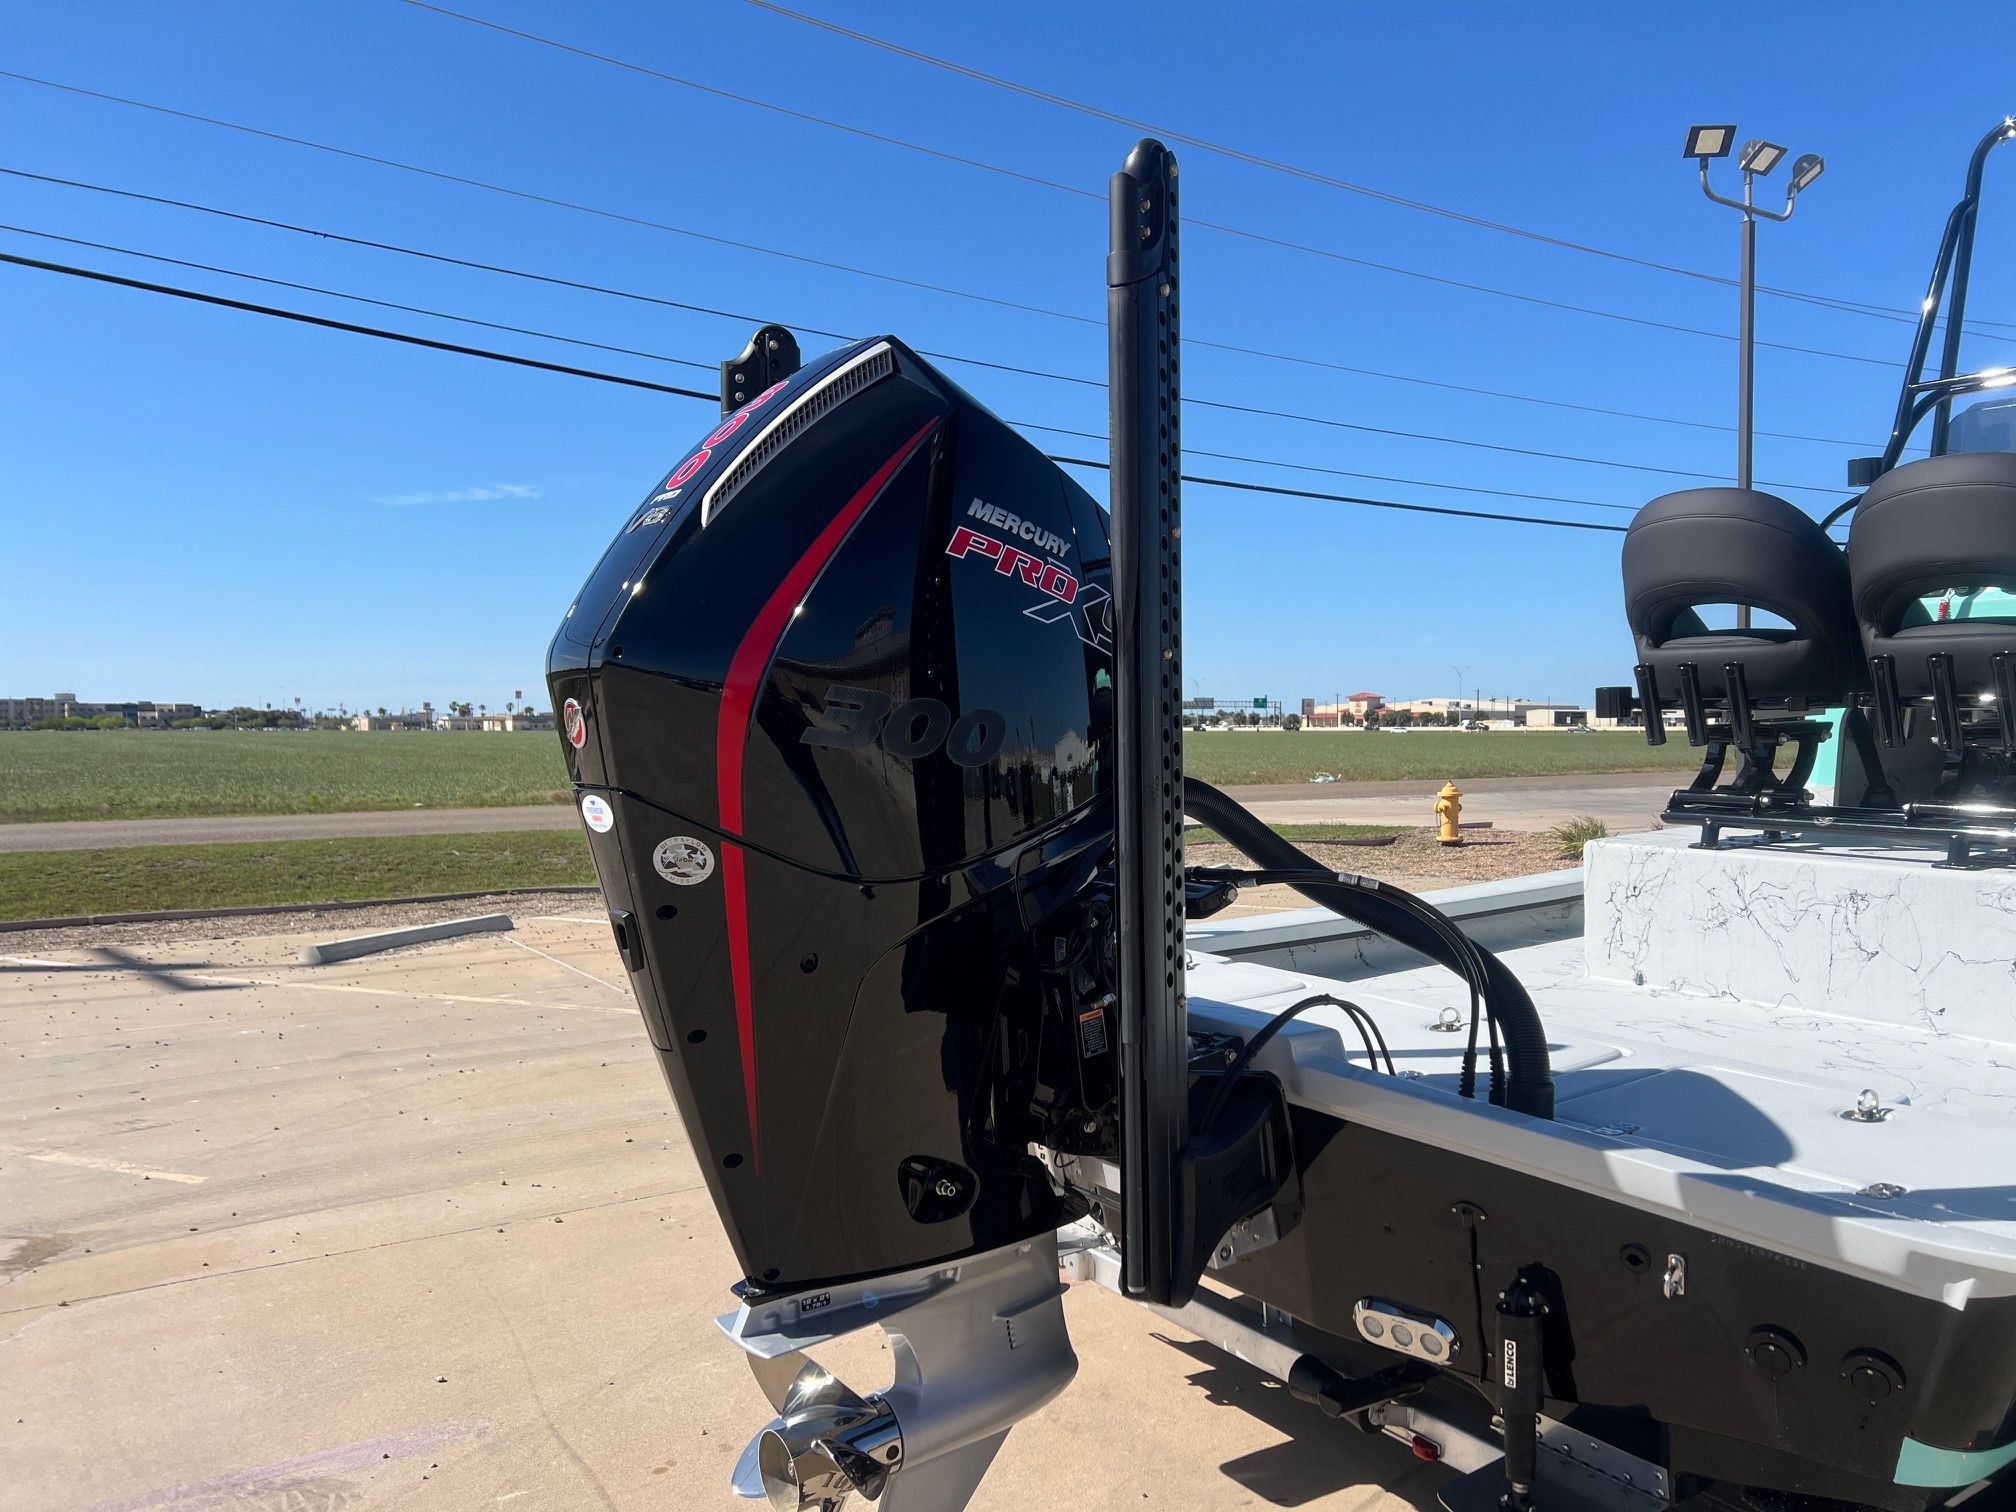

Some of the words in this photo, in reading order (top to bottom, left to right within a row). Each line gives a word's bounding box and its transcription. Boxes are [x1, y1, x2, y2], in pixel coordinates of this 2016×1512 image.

[945, 526, 1078, 604] PRO
[966, 498, 1072, 557] MERCURY
[1023, 556, 1112, 657] X
[799, 684, 1007, 768] 300
[1506, 1341, 1515, 1377] LENCO
